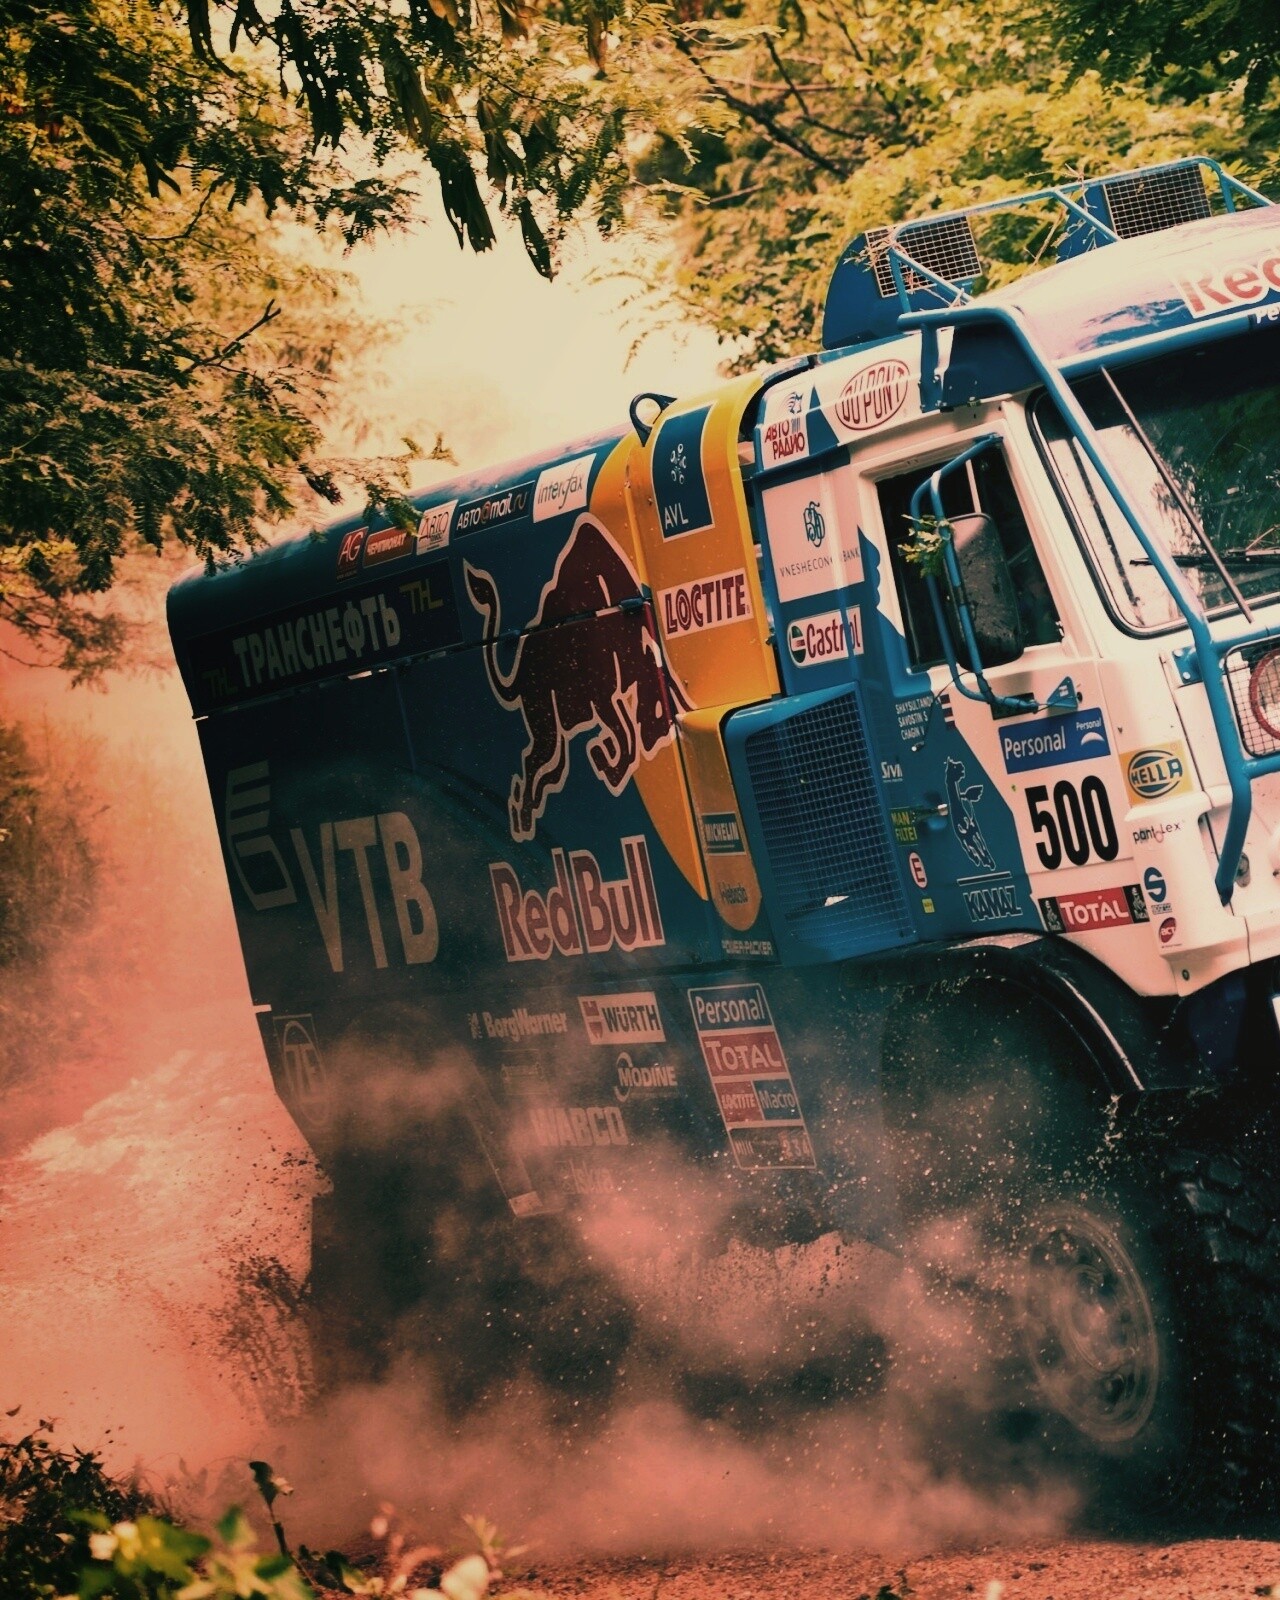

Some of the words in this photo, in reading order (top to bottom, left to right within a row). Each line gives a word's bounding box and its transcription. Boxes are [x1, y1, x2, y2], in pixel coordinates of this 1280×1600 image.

[664, 503, 689, 529] AVL
[665, 573, 746, 634] LOCTITE
[232, 593, 401, 687] ТРАНСНЕФТЬ
[1076, 717, 1102, 731] Personal
[1004, 726, 1066, 760] Personal
[1131, 758, 1183, 785] HELLA
[1024, 775, 1119, 870] 500
[290, 811, 439, 972] VTB
[490, 850, 582, 960] Red
[570, 838, 664, 951] Bull
[963, 885, 1024, 922] KAMAZ
[1060, 898, 1129, 926] TOTAL
[695, 989, 766, 1024] Personal
[482, 1008, 568, 1042] BorgWarner
[704, 1041, 782, 1071] TOTAL
[758, 1090, 796, 1109] Macro
[530, 1106, 629, 1146] WABCO
